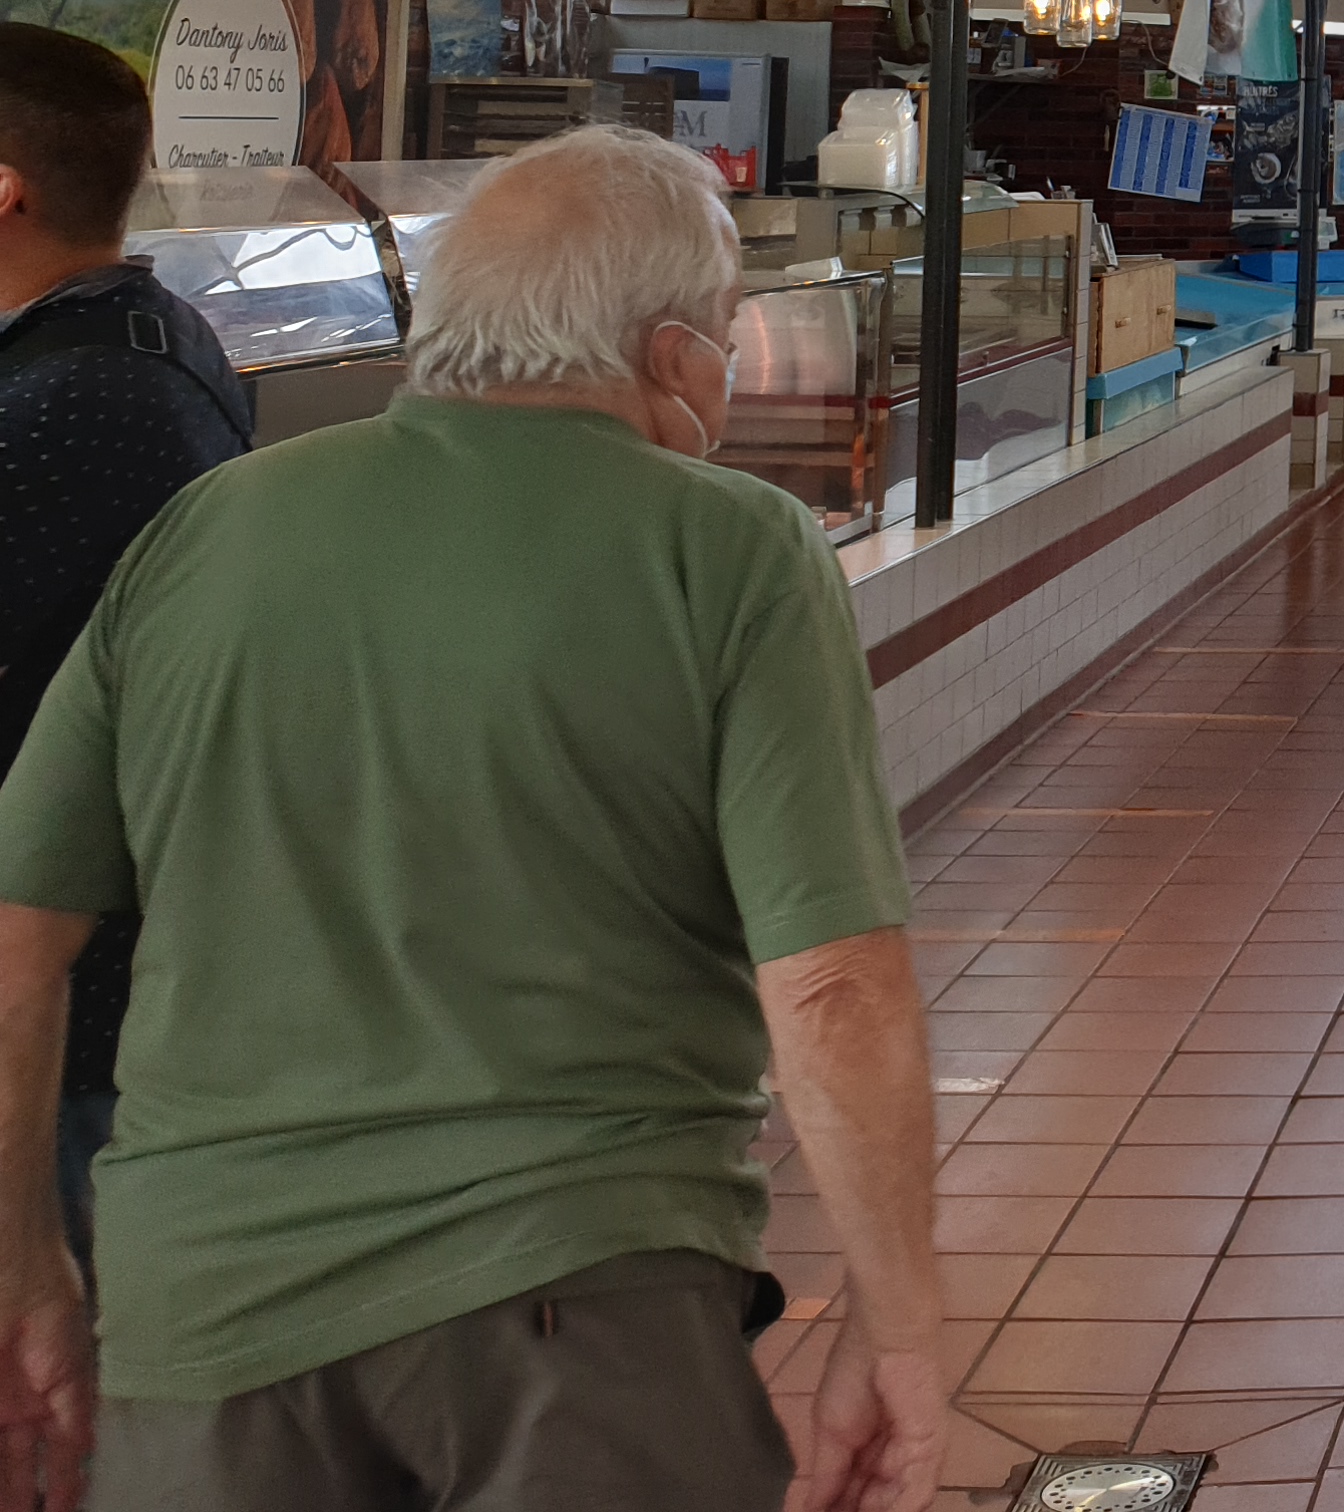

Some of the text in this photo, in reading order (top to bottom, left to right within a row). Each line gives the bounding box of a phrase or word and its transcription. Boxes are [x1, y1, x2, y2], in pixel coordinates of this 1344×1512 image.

[175, 17, 289, 64] Dantony Joris
[175, 64, 286, 93] 06 63 47 05 66
[168, 144, 229, 169] Charcutier
[241, 144, 286, 169] Traiteur
